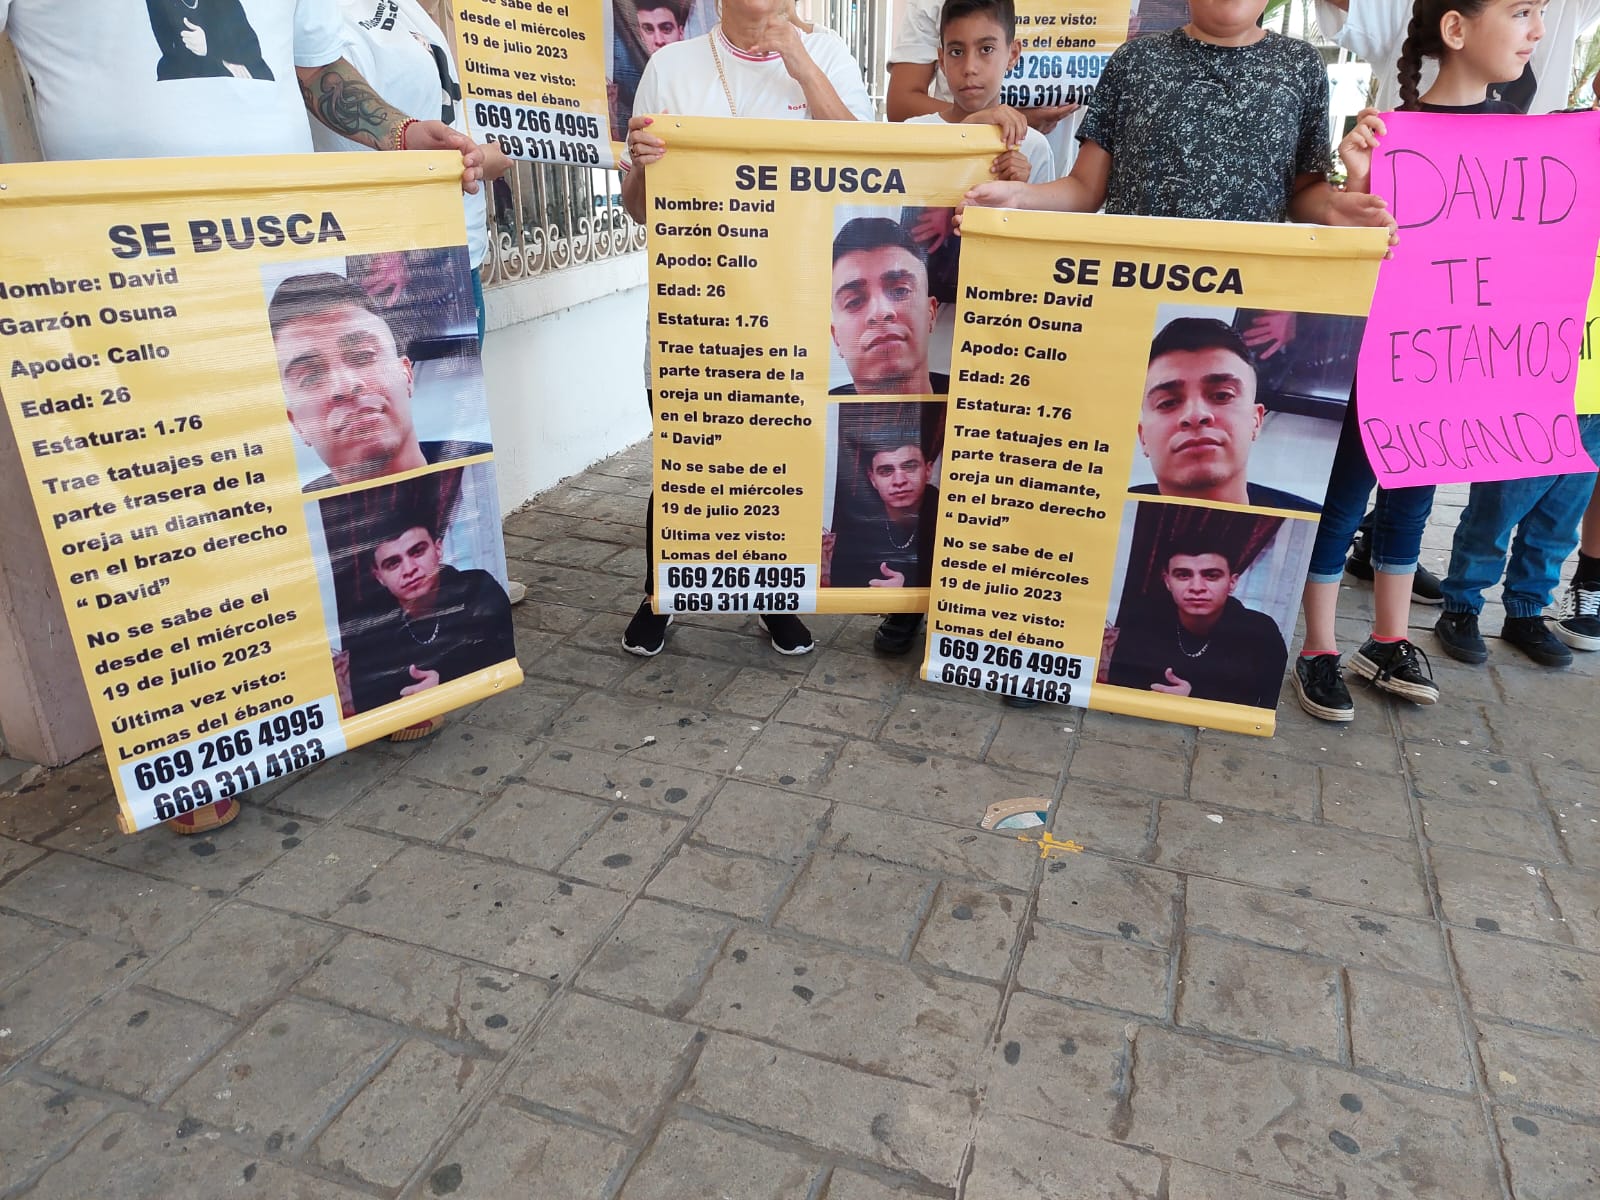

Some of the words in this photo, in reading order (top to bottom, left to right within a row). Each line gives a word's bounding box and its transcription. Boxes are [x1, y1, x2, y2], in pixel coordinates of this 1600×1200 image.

[536, 0, 553, 14] de
[556, 4, 569, 18] el
[1034, 16, 1057, 26] vez
[1060, 12, 1097, 26] visto:
[459, 9, 501, 28] desde
[504, 18, 517, 31] el
[520, 22, 586, 41] miércoles
[462, 32, 479, 46] 19
[483, 35, 500, 49] de
[503, 38, 532, 55] julio
[536, 44, 568, 60] 2023
[1032, 35, 1052, 48] del
[1056, 35, 1096, 48] ébano
[464, 57, 511, 78] Última
[513, 70, 538, 82] vez
[539, 72, 576, 87] visto:
[1028, 55, 1062, 80] 266
[467, 82, 514, 100] Lomas
[516, 89, 538, 104] del
[541, 92, 580, 108] ébano
[1034, 85, 1061, 107] 311
[474, 102, 513, 130] 669
[514, 108, 552, 134] 266
[554, 112, 599, 140] 4995
[525, 136, 557, 161] 311
[560, 141, 599, 164] 4183
[735, 164, 778, 191] SE
[790, 166, 906, 194] BUSCA
[1384, 149, 1577, 230] DAVID
[654, 196, 724, 212] Nombre:
[729, 198, 775, 213] David
[108, 222, 176, 260] SE
[188, 211, 347, 254] BUSCA
[654, 222, 712, 237] Garzón
[717, 224, 769, 238] Osuna
[655, 252, 712, 270] Apodo:
[716, 254, 758, 268] Callo
[108, 267, 179, 290] David
[656, 282, 701, 297] Edad:
[706, 284, 726, 298] 26
[1052, 257, 1101, 286] SE
[1111, 260, 1244, 295] BUSCA
[1431, 256, 1492, 306] TE
[965, 286, 1038, 304] Nombre:
[1043, 291, 1094, 308] David
[0, 310, 92, 336] Garzón
[99, 305, 178, 325] Osuna
[657, 312, 730, 327] Estatura:
[735, 314, 769, 328] 1.76
[963, 310, 1022, 328] Garzón
[1028, 316, 1083, 333] Osuna
[10, 352, 101, 380] Apodo:
[107, 342, 170, 364] Callo
[960, 340, 1019, 357] Apodo:
[1024, 345, 1068, 362] Callo
[1389, 317, 1576, 384] ESTAMOS
[958, 369, 1005, 385] Edad:
[1009, 373, 1031, 387] 26
[20, 392, 94, 419] Edad:
[100, 386, 132, 406] 26
[659, 388, 699, 403] oreja
[704, 391, 723, 402] un
[727, 389, 804, 407] diamante,
[956, 397, 1031, 416] Estatura:
[1036, 404, 1072, 420] 1.76
[660, 412, 679, 422] en
[683, 410, 698, 423] el
[702, 410, 745, 425] brazo
[748, 413, 812, 427] derecho
[32, 427, 147, 458] Estatura:
[154, 414, 203, 436] 1.76
[1362, 412, 1576, 474] BUSCANDO
[660, 480, 706, 495] desde
[710, 483, 724, 496] el
[728, 484, 804, 496] miércoles
[949, 470, 990, 486] oreja
[994, 474, 1014, 486] un
[1018, 476, 1101, 500] diamante,
[661, 502, 680, 514] 19
[683, 503, 702, 516] de
[705, 504, 739, 519] julio
[743, 504, 780, 516] 2023
[946, 493, 967, 504] en
[971, 492, 986, 505] el
[990, 493, 1035, 510] brazo
[1039, 500, 1106, 520] derecho
[661, 526, 711, 541] Última
[714, 532, 741, 541] vez
[744, 529, 786, 542] visto:
[661, 549, 711, 561] Lomas
[714, 549, 738, 561] del
[742, 549, 788, 562] ébano
[667, 566, 708, 589] 669
[711, 567, 750, 588] 266
[754, 568, 806, 588] 4995
[940, 556, 988, 572] desde
[991, 562, 1007, 574] el
[1010, 566, 1090, 586] miércoles
[673, 592, 714, 612] 669
[717, 592, 749, 612] 311
[752, 592, 800, 611] 4183
[940, 576, 958, 589] 19
[962, 578, 982, 591] de
[983, 581, 1019, 596] julio
[1023, 584, 1062, 602] 2023
[86, 631, 120, 649] No
[127, 622, 154, 638] se
[160, 606, 213, 630] sabe
[219, 598, 245, 614] de
[250, 588, 270, 605] el
[937, 598, 986, 618] Última
[991, 610, 1018, 622] vez
[1021, 612, 1065, 628] visto:
[94, 648, 164, 676] desde
[170, 636, 191, 654] el
[196, 606, 297, 648] miércoles
[935, 619, 984, 640] Lomas
[988, 628, 1013, 644] del
[1016, 631, 1064, 650] ébano
[102, 682, 130, 701] 19
[136, 675, 164, 692] de
[170, 659, 216, 686] julio
[221, 640, 272, 667] 2023
[939, 636, 980, 662] 669
[982, 644, 1024, 672] 266
[1027, 652, 1081, 679] 4995
[941, 662, 982, 688] 669
[985, 669, 1020, 696] 311
[1022, 679, 1071, 705] 4183
[111, 703, 185, 734] Última
[189, 689, 227, 709] vez
[230, 671, 286, 696] visto:
[118, 728, 192, 761] Lomas
[196, 712, 229, 734] del
[234, 694, 294, 722] ébano
[134, 749, 194, 792] 669
[197, 728, 254, 771] 266
[258, 702, 324, 748] 4995
[152, 779, 214, 822] 669
[214, 760, 261, 798] 311
[266, 736, 326, 779] 4183
